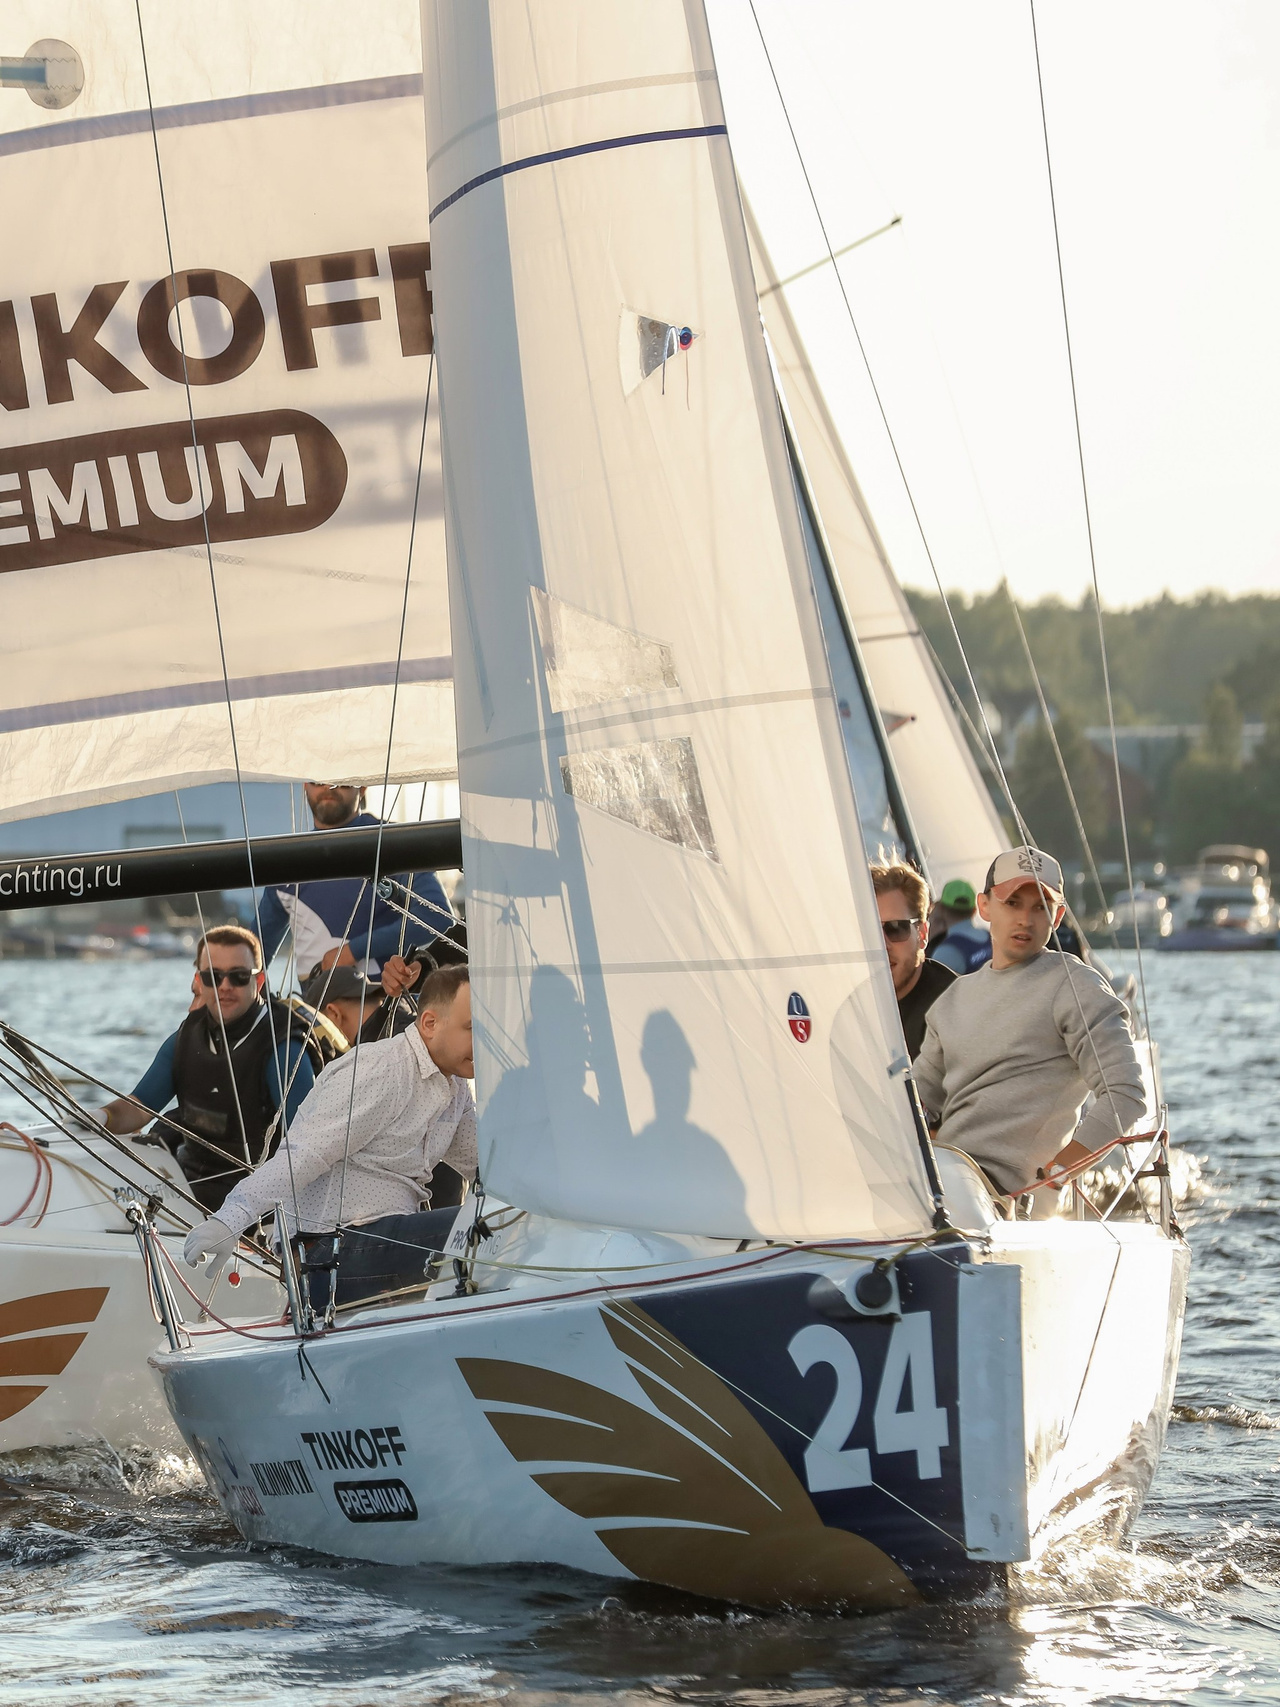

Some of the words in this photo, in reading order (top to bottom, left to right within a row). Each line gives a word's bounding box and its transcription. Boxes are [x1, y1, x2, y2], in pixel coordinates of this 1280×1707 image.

[787, 1310, 950, 1493] 24
[300, 1426, 407, 1471] TINKOFF
[249, 1460, 314, 1497] ВЕДОМОСТИ
[337, 1487, 414, 1515] PREMIUM
